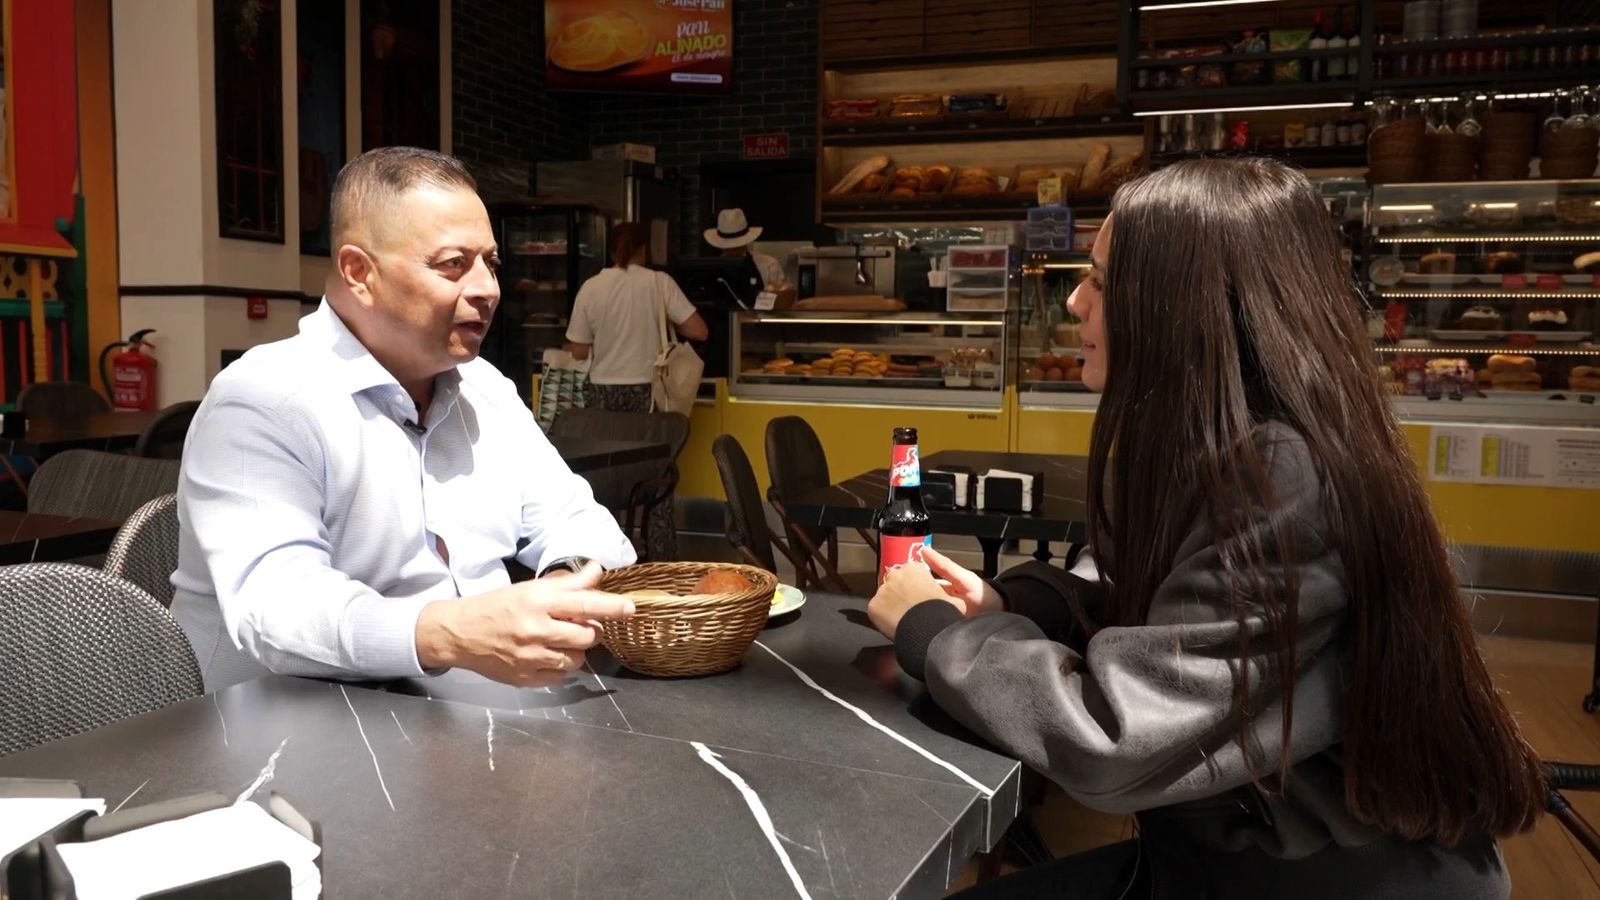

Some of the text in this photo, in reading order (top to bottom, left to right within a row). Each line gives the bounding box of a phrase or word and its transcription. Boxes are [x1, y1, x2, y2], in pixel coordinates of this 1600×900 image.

[677, 20, 709, 38] pan
[756, 136, 778, 146] SIN
[747, 146, 786, 157] SALIDA
